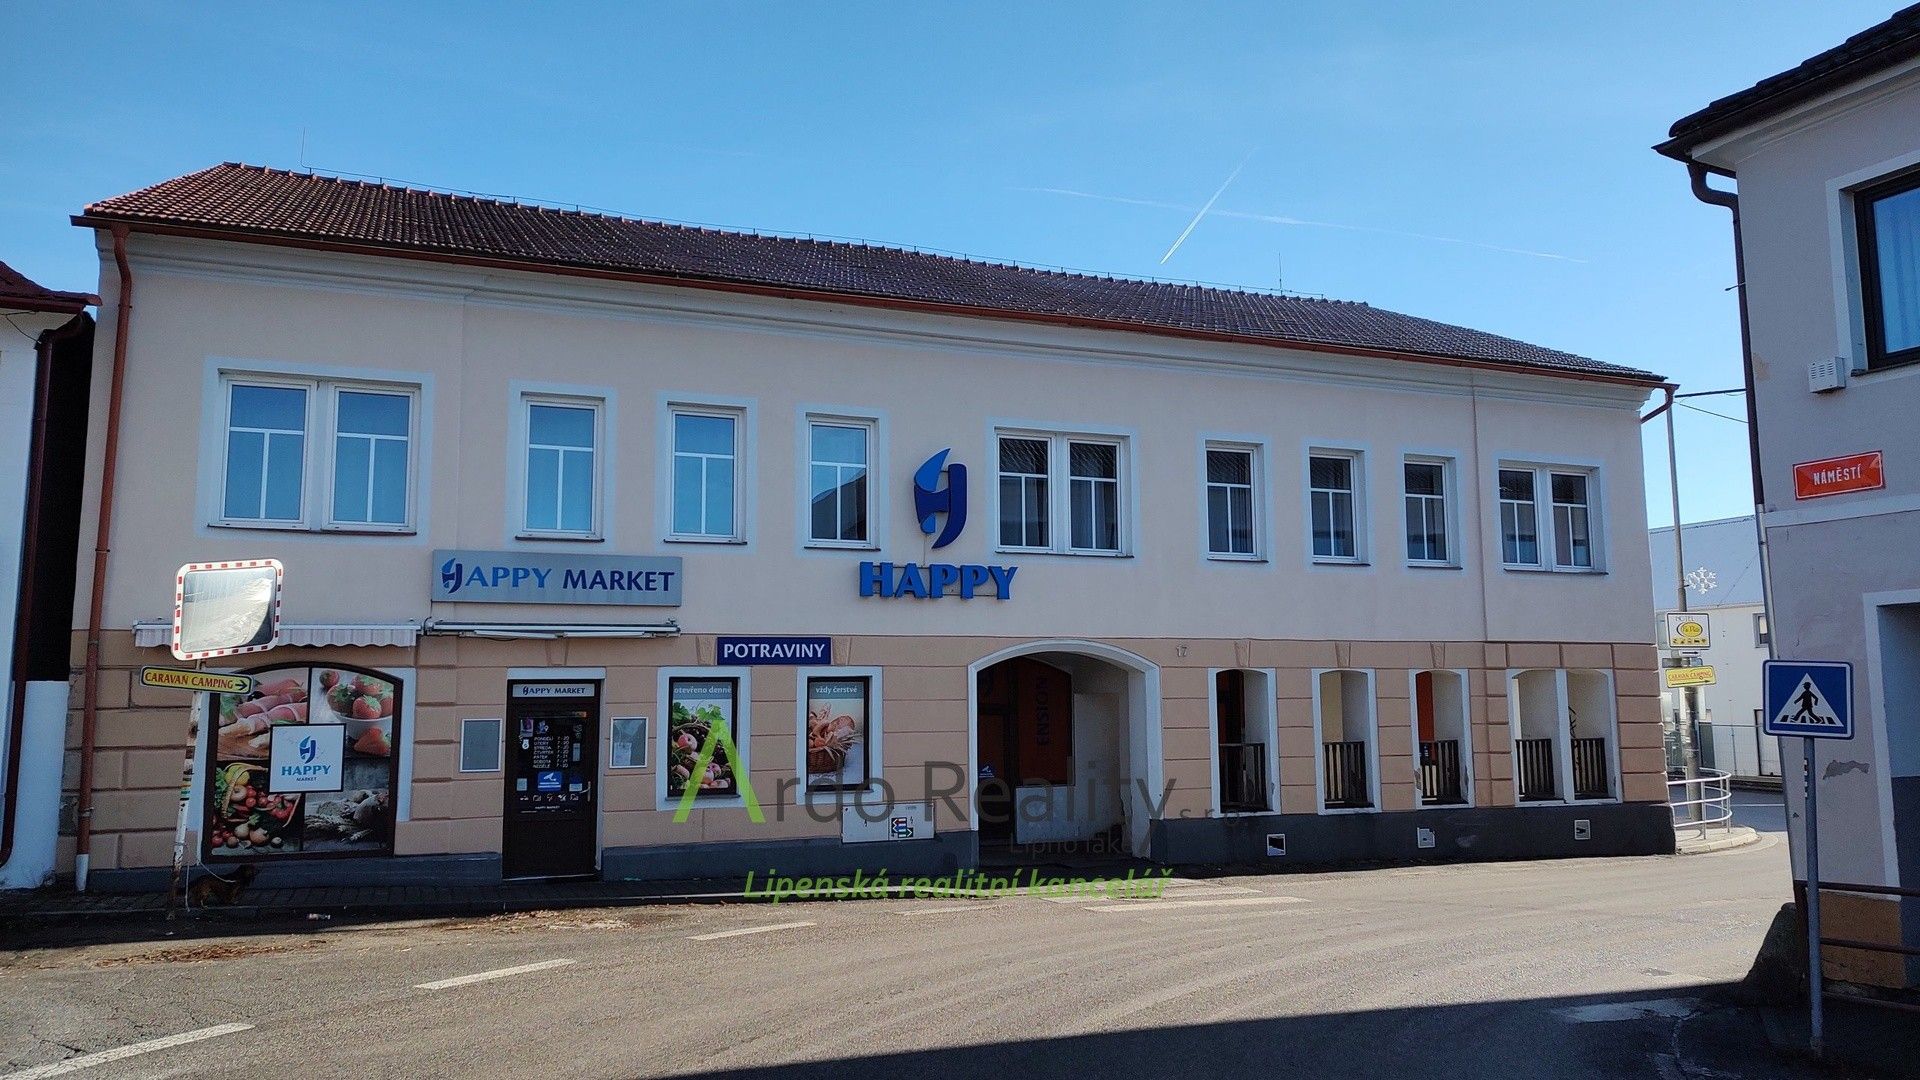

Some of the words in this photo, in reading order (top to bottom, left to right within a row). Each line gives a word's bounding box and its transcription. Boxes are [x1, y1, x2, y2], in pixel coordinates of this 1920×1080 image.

[1813, 463, 1861, 485] NÁMĚSTÍ
[562, 569, 675, 592] MARKET
[860, 562, 1018, 600] HAPPY
[723, 643, 825, 658] POTRAVINY
[1176, 646, 1188, 657] 17
[144, 672, 189, 685] CARAVAN
[191, 676, 233, 689] CAMPING
[815, 686, 832, 695] vždy
[832, 685, 858, 693] čerstvé
[281, 765, 331, 776] HAPPY
